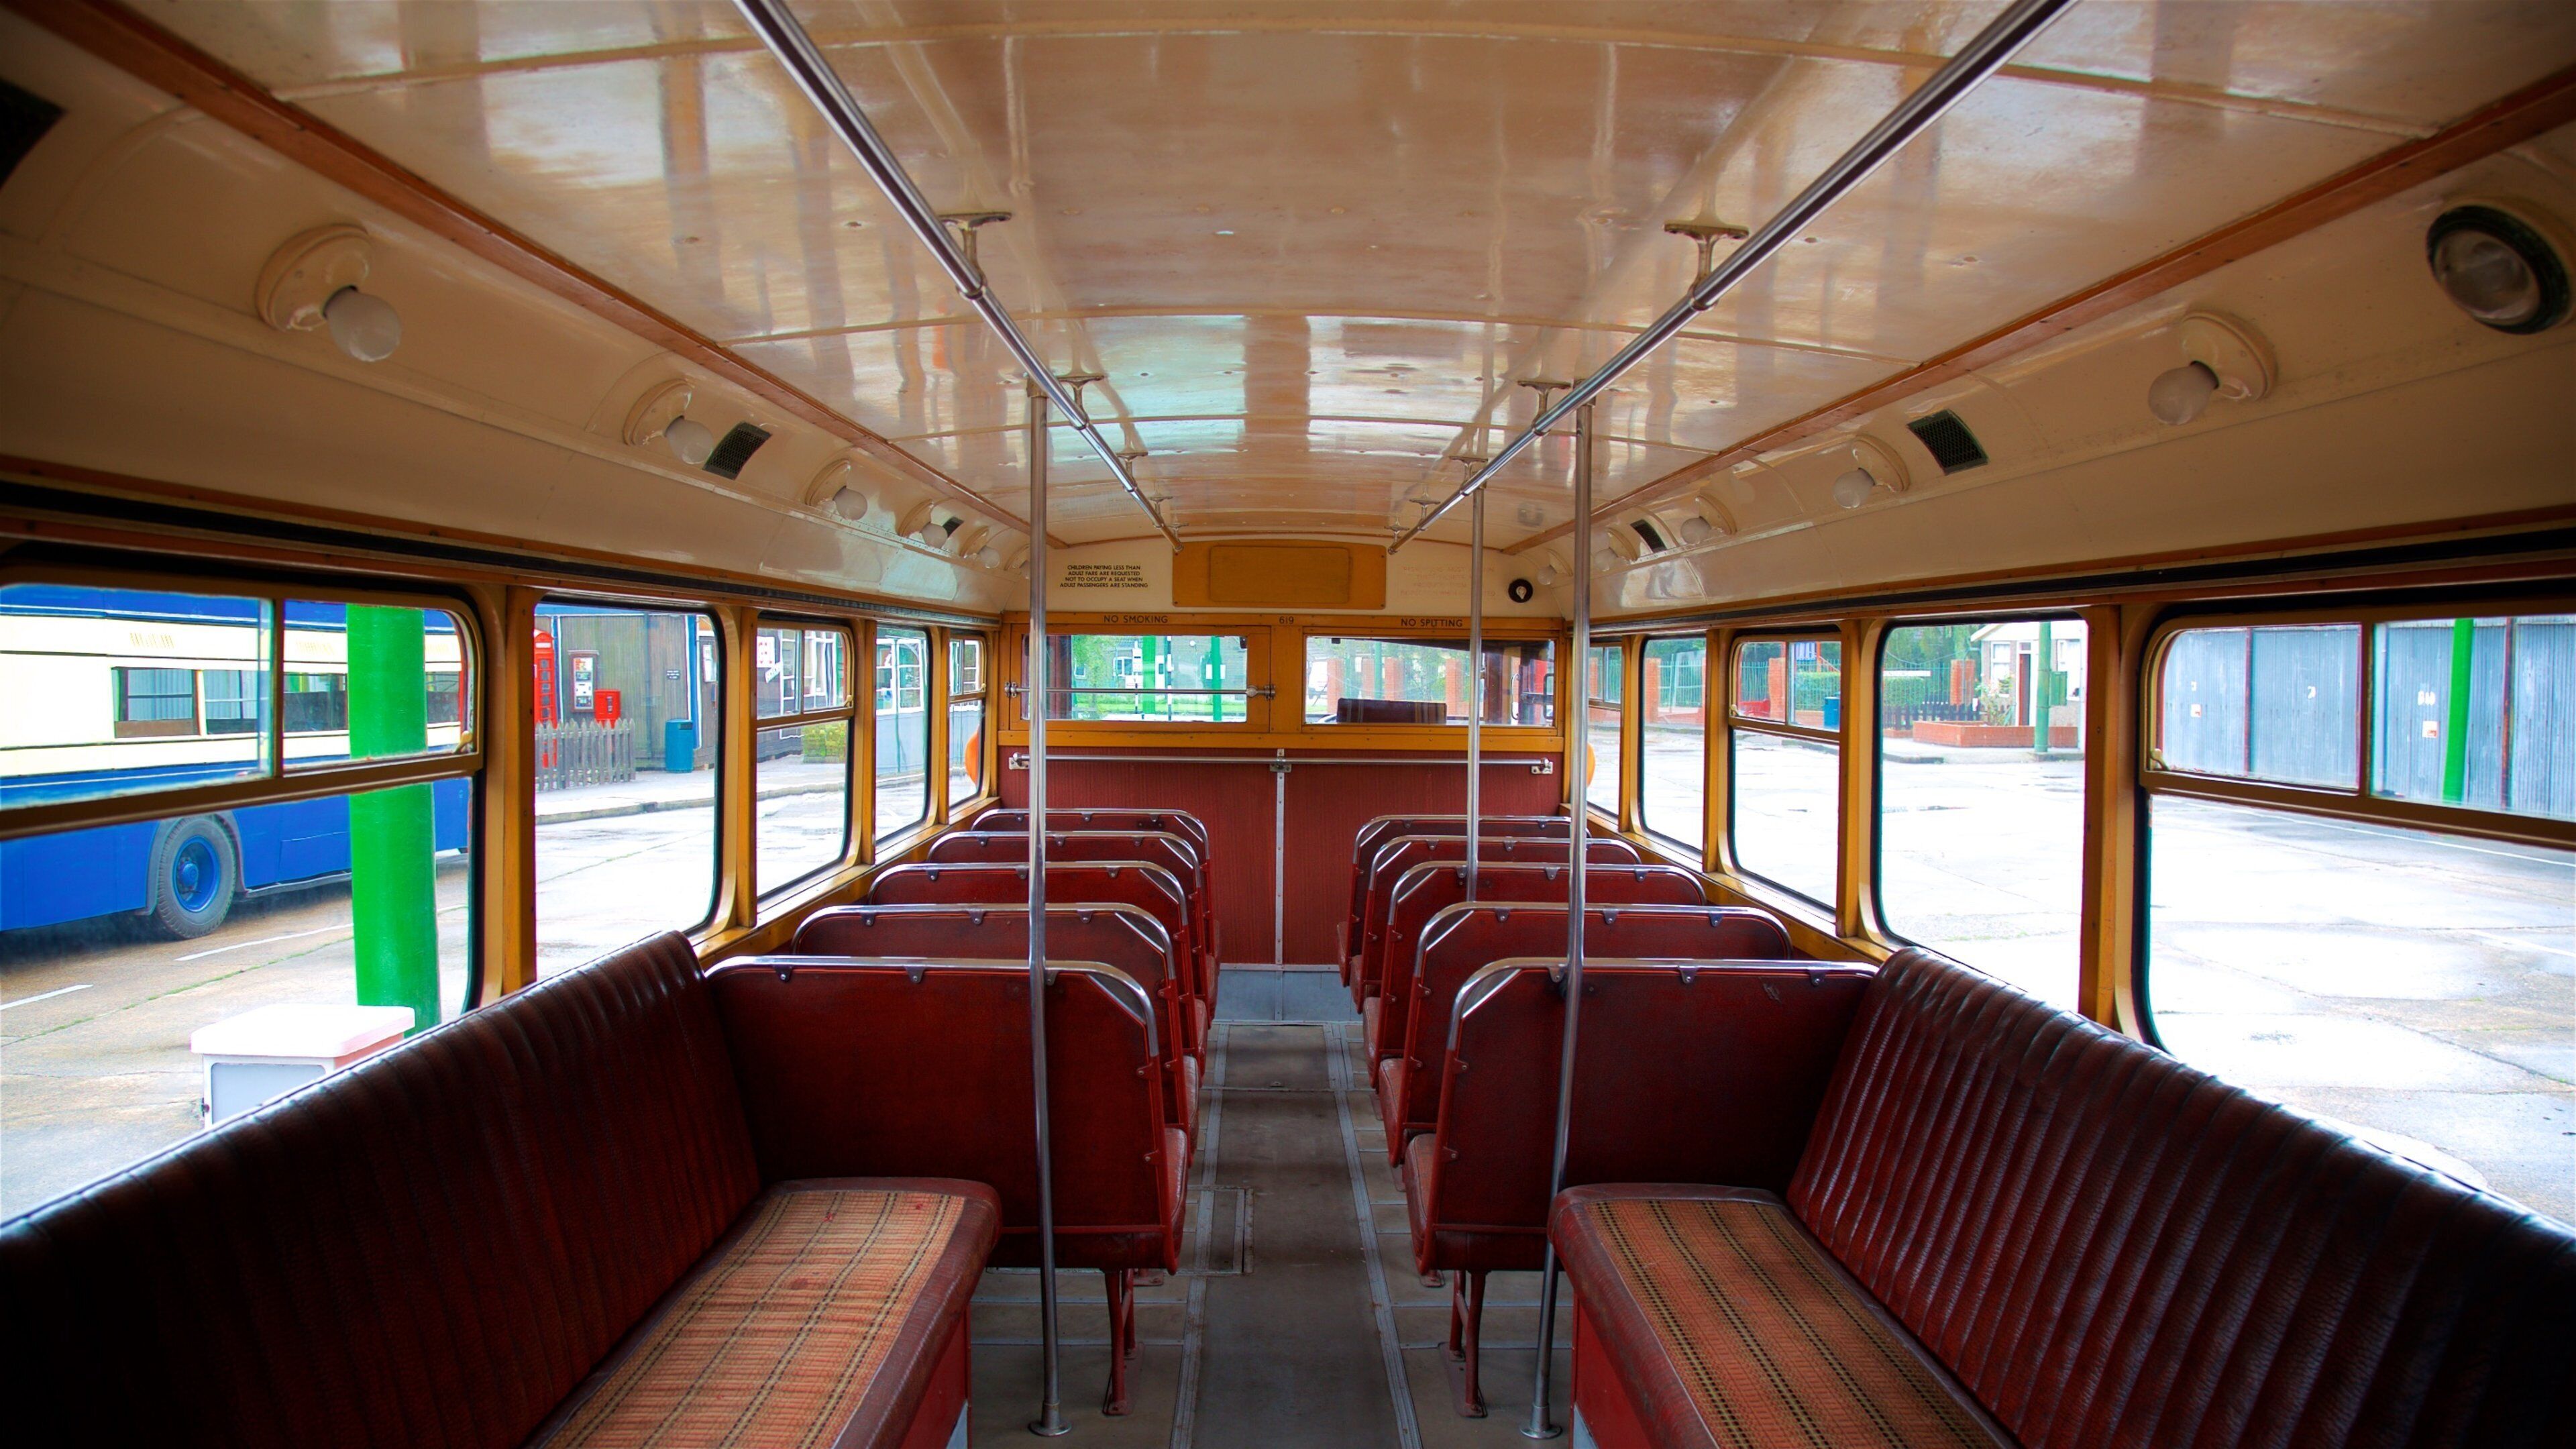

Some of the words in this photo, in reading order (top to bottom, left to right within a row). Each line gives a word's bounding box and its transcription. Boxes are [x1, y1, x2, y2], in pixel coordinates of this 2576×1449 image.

[1104, 615, 1119, 623] NO
[1123, 615, 1168, 623] SMOKING
[1279, 616, 1295, 624] 619
[1401, 619, 1417, 627] NO
[1420, 619, 1463, 627] SPITTING
